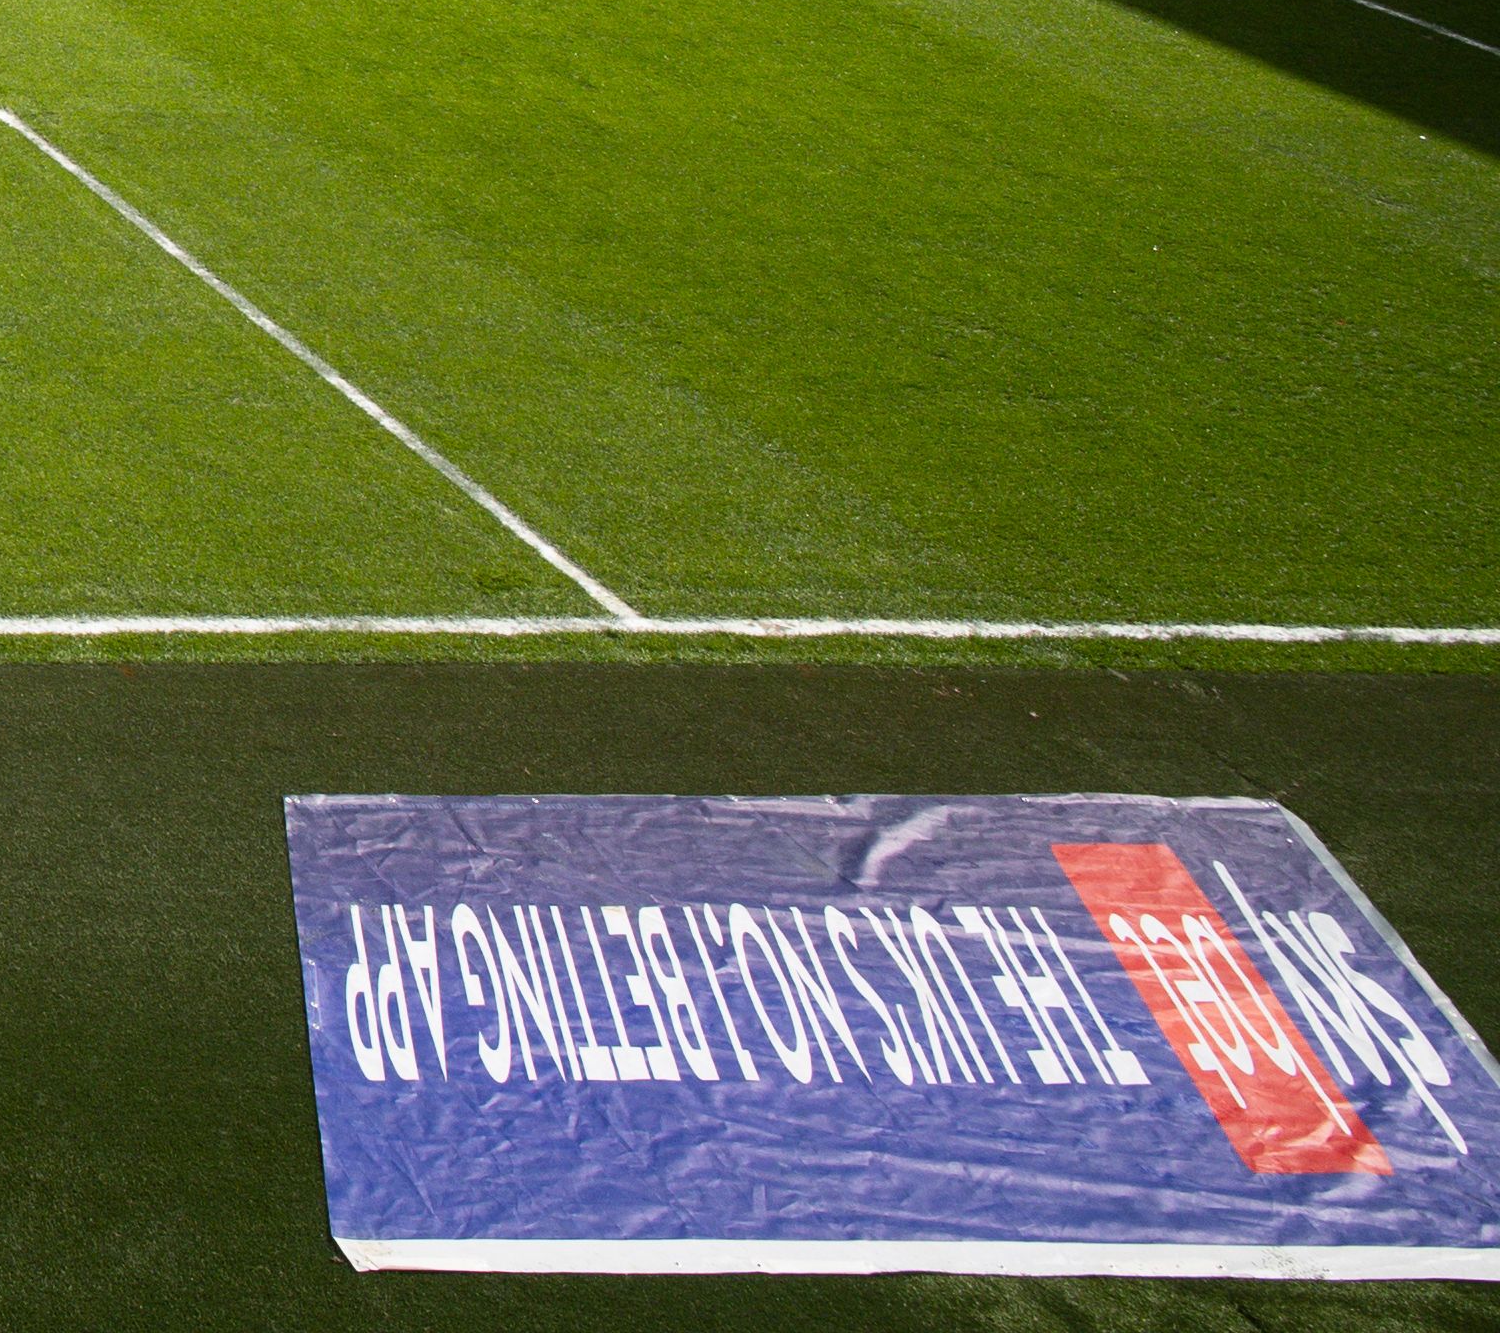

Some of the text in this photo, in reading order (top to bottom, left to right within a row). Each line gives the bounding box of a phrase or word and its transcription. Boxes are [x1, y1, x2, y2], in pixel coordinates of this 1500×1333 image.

[345, 860, 1470, 1155] sky bet THE UK'S NO.1 BETTING APP
